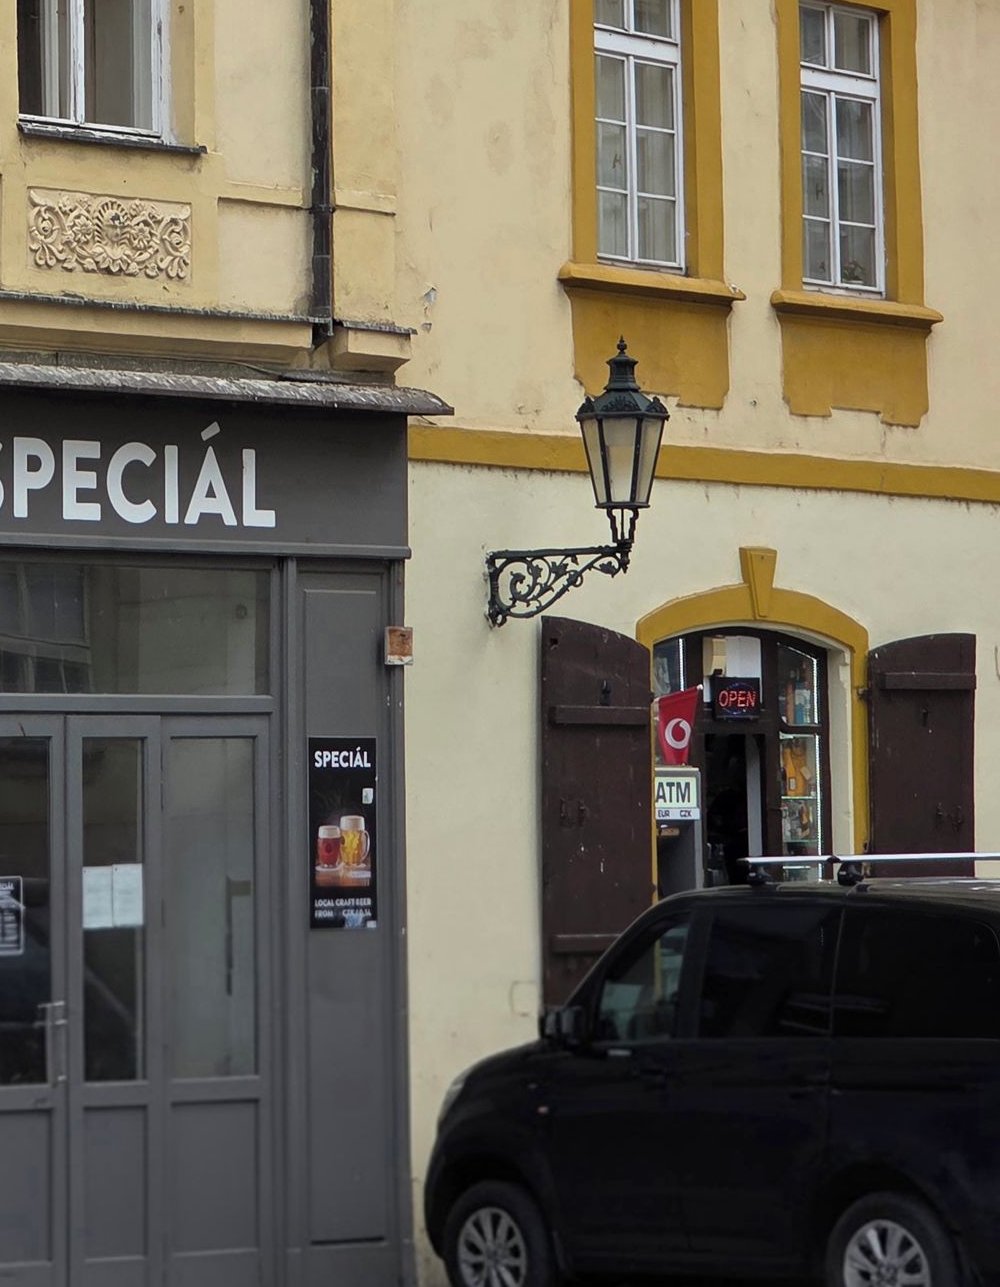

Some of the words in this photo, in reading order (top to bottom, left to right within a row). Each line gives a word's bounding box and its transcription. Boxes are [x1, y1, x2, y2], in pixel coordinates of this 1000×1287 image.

[719, 690, 756, 707] OPEN
[314, 746, 371, 768] SPECIÁL
[655, 782, 690, 803] ATM
[314, 899, 334, 907] LOCAL
